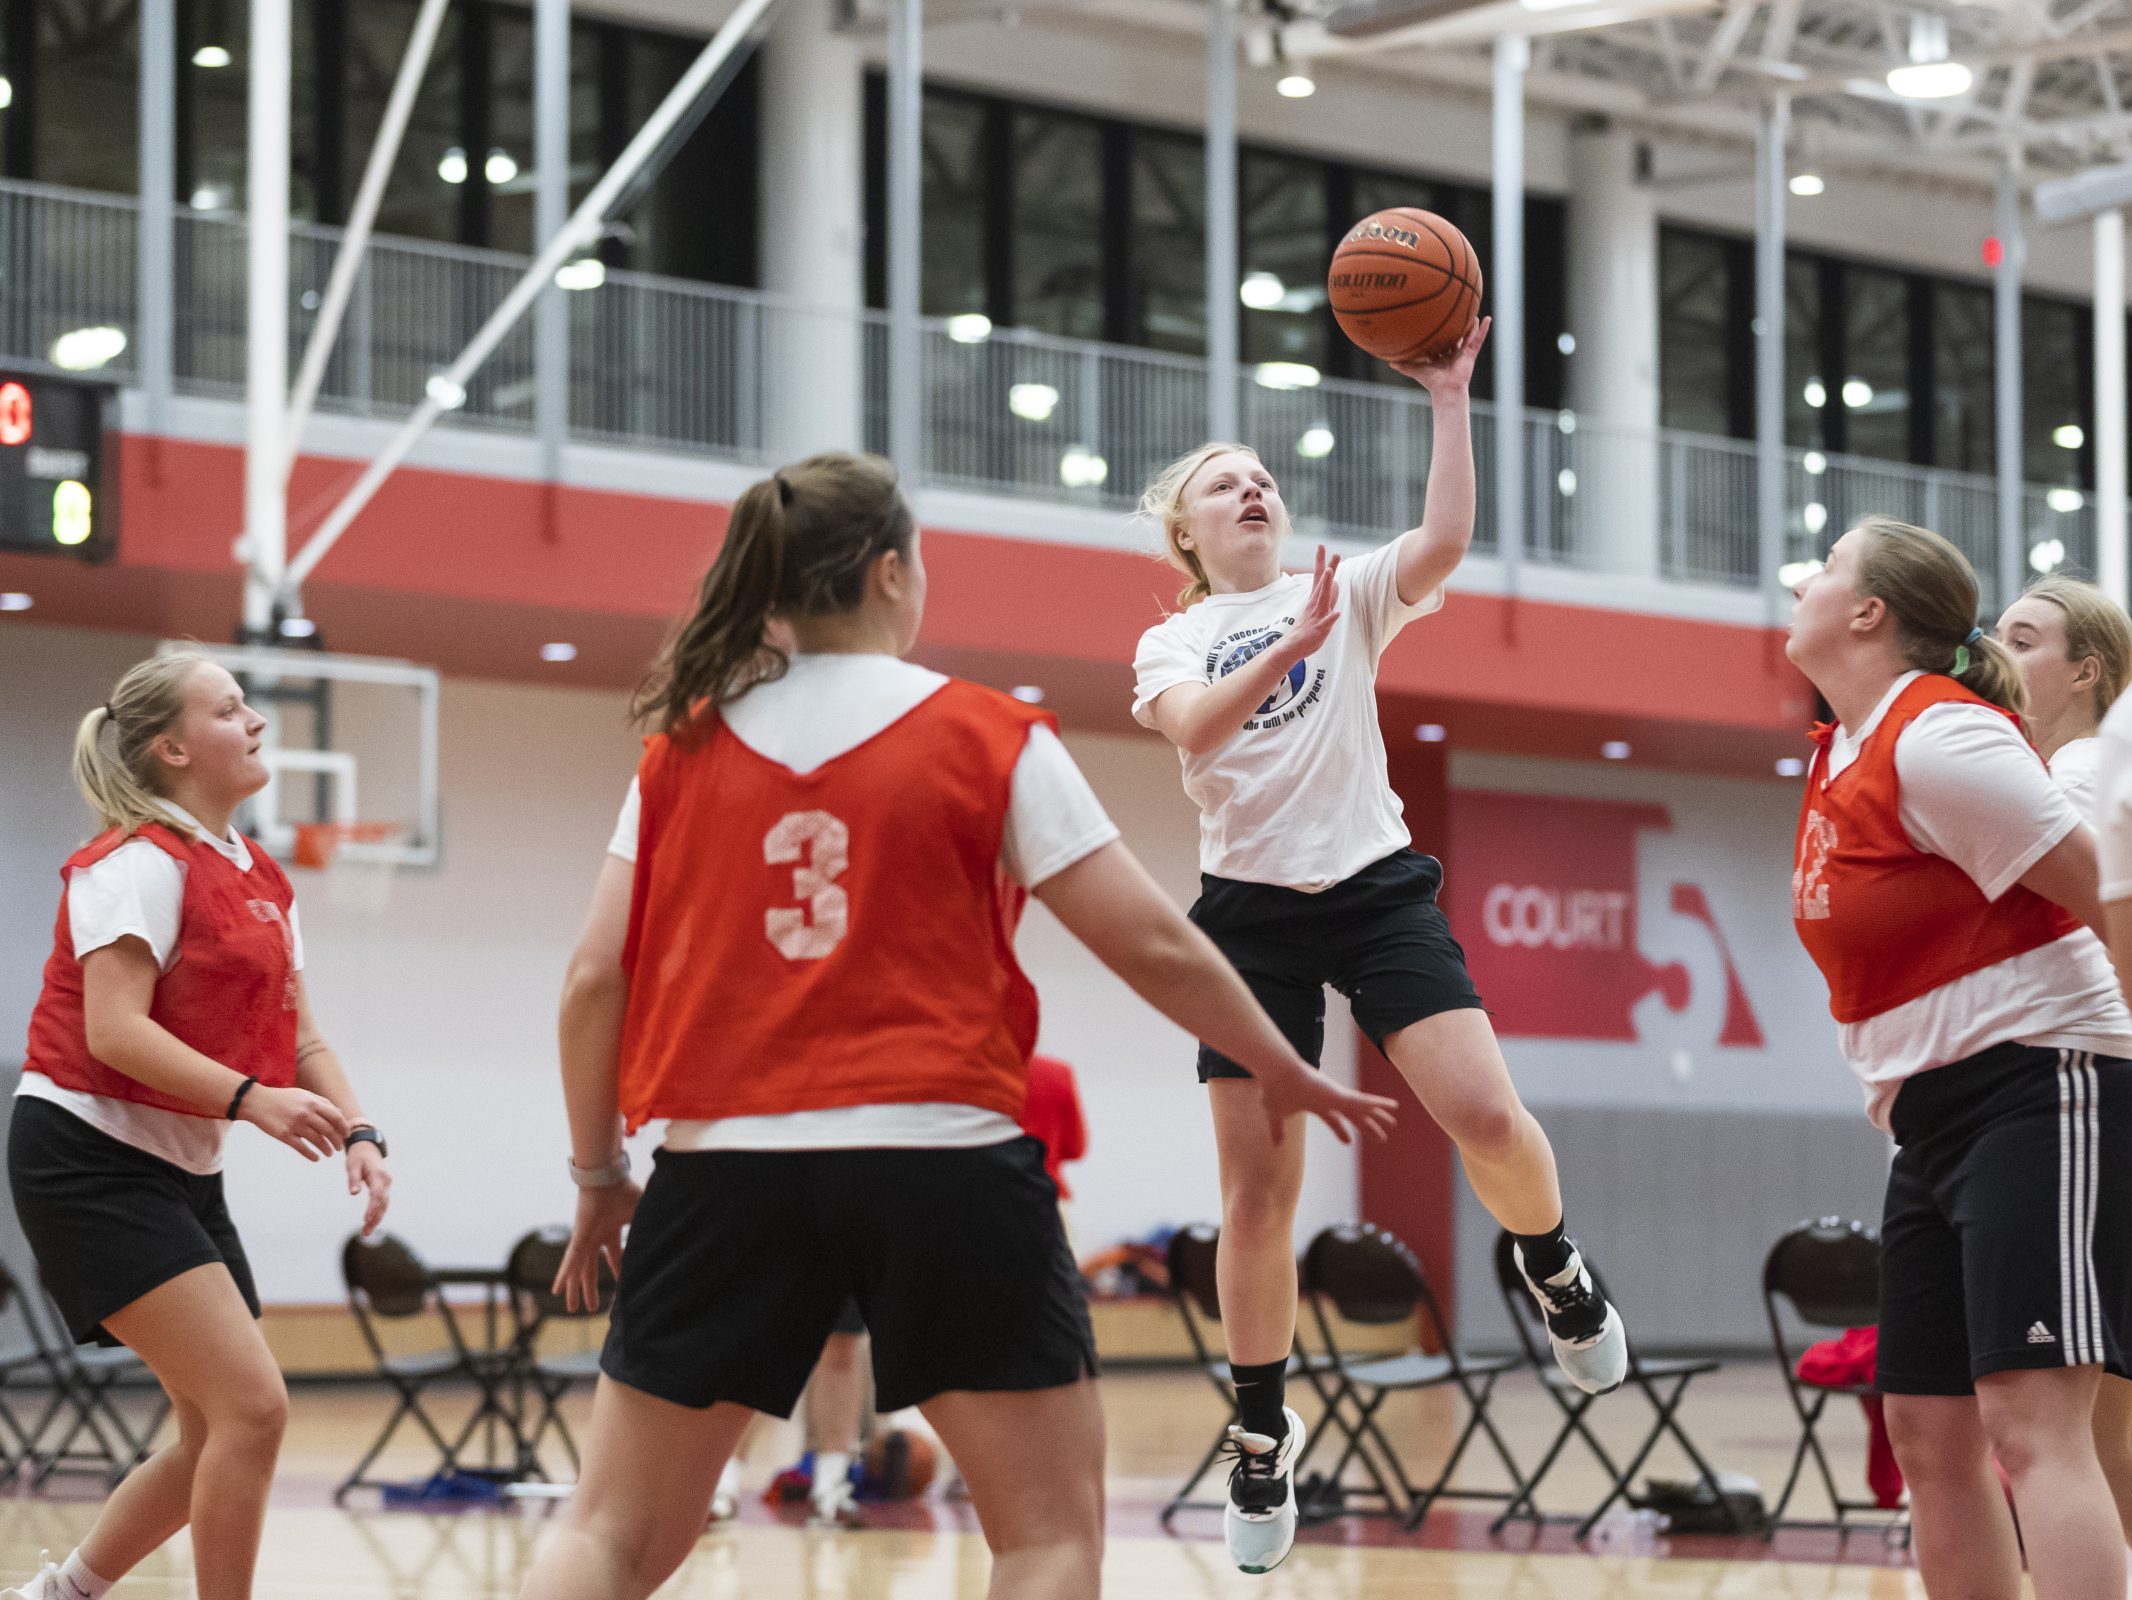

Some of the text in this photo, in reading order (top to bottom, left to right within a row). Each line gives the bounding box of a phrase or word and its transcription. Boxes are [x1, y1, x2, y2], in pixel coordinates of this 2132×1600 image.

[1262, 715, 1281, 729] will
[763, 808, 849, 961] 3
[1483, 884, 1628, 948] COURT
